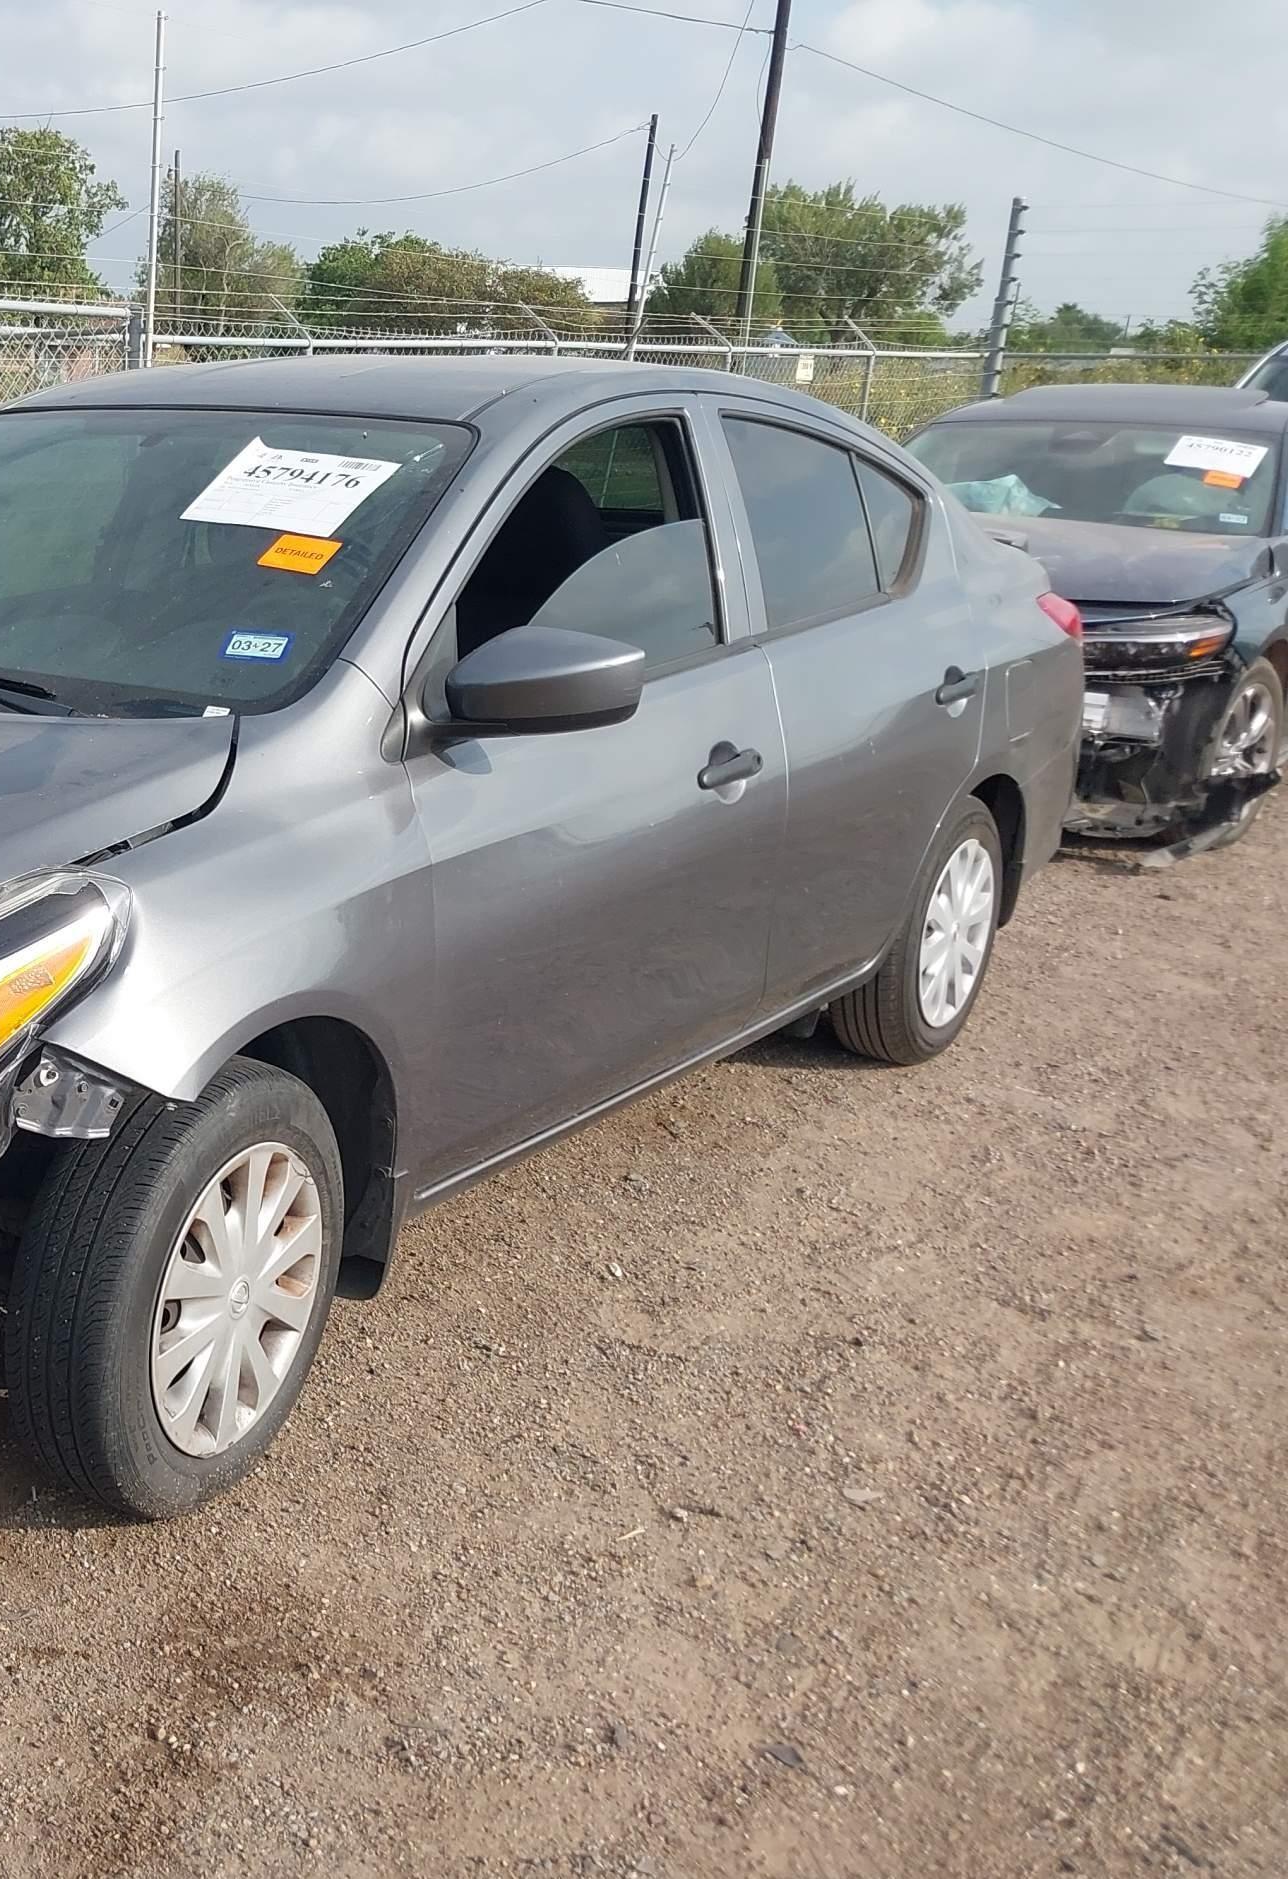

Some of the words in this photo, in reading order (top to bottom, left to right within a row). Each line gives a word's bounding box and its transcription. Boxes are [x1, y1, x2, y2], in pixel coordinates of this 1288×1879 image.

[243, 464, 363, 489] 45794176
[274, 547, 324, 561] DETAILED
[231, 640, 253, 651] 03
[259, 641, 283, 653] 27
